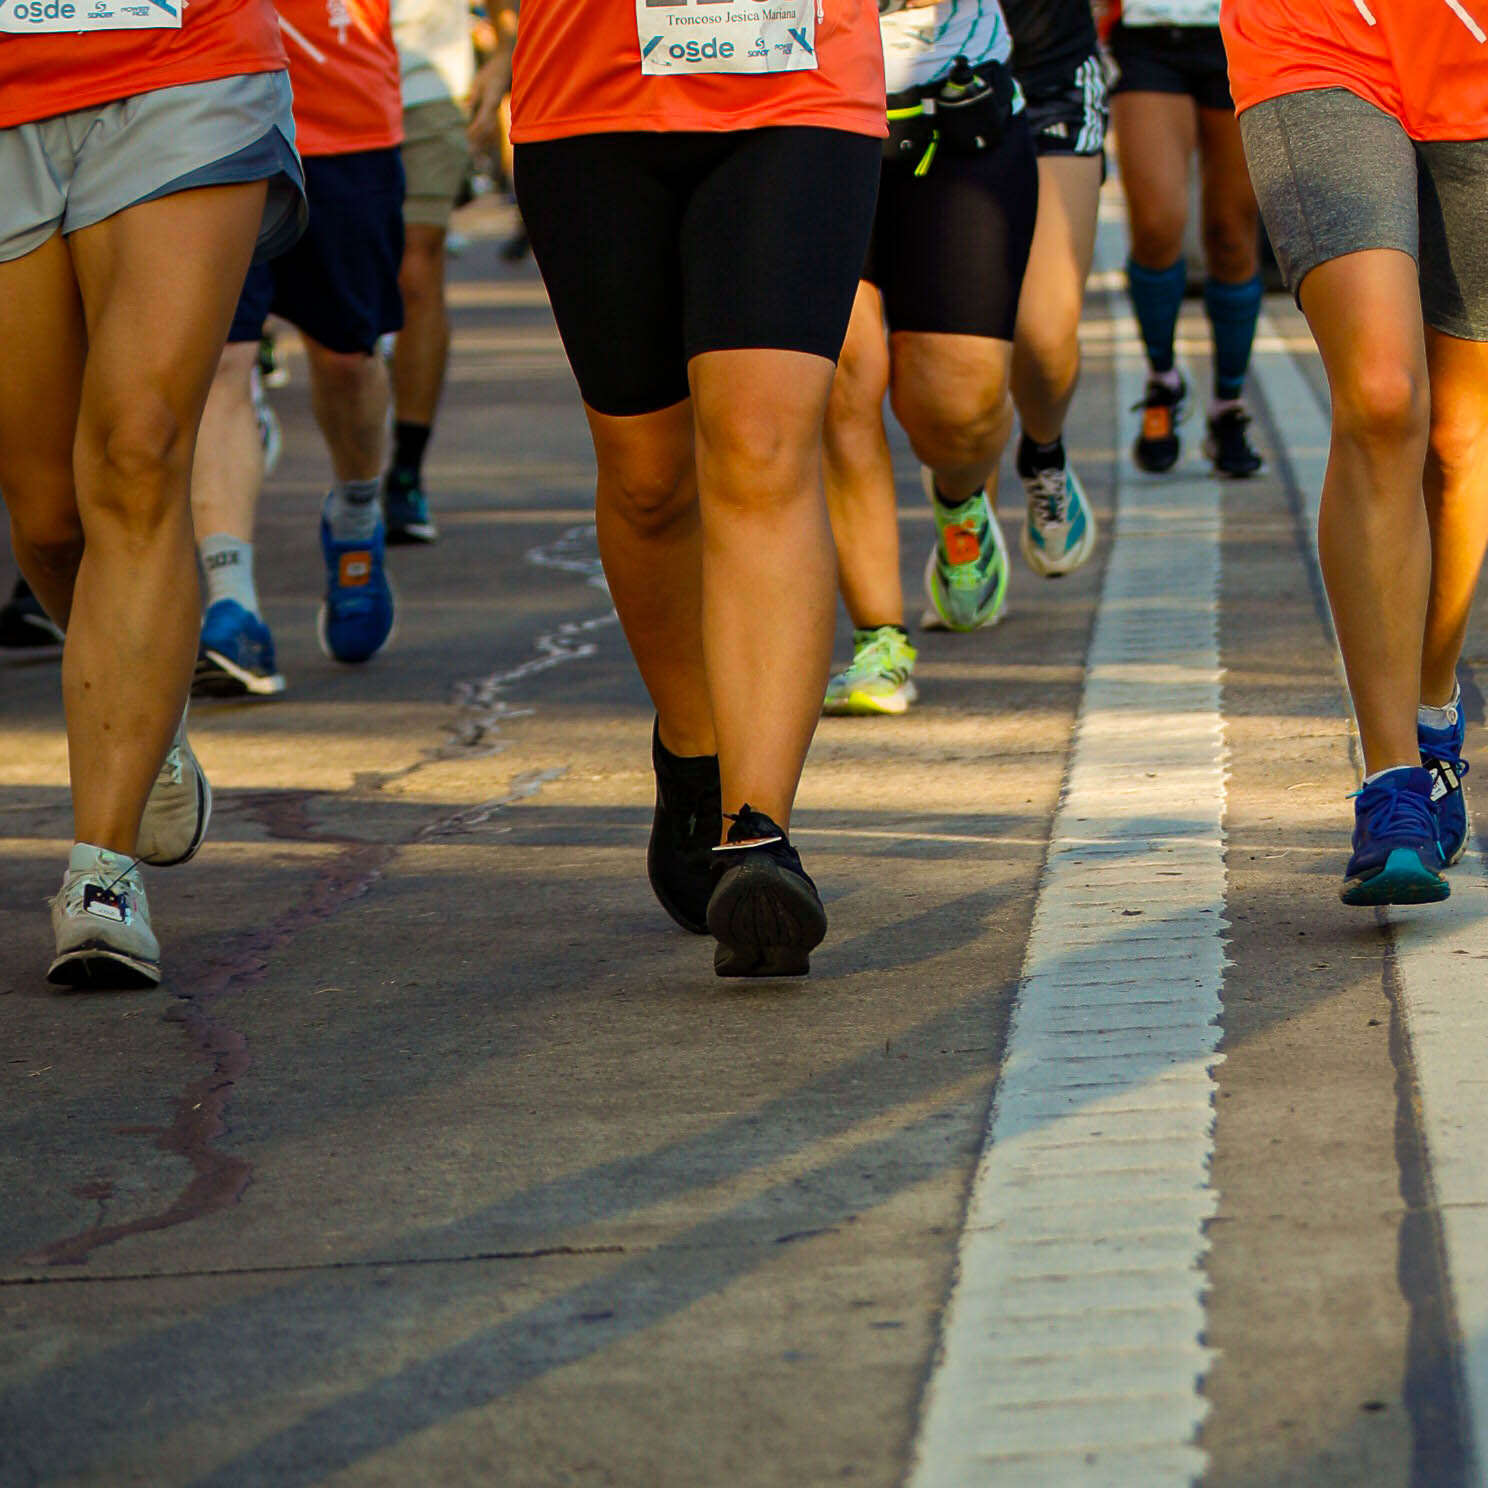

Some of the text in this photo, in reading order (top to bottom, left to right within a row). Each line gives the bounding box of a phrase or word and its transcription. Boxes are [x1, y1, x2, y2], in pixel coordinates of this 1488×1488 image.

[666, 8, 797, 26] Troncoso Jesica Mariana
[668, 36, 735, 60] osde
